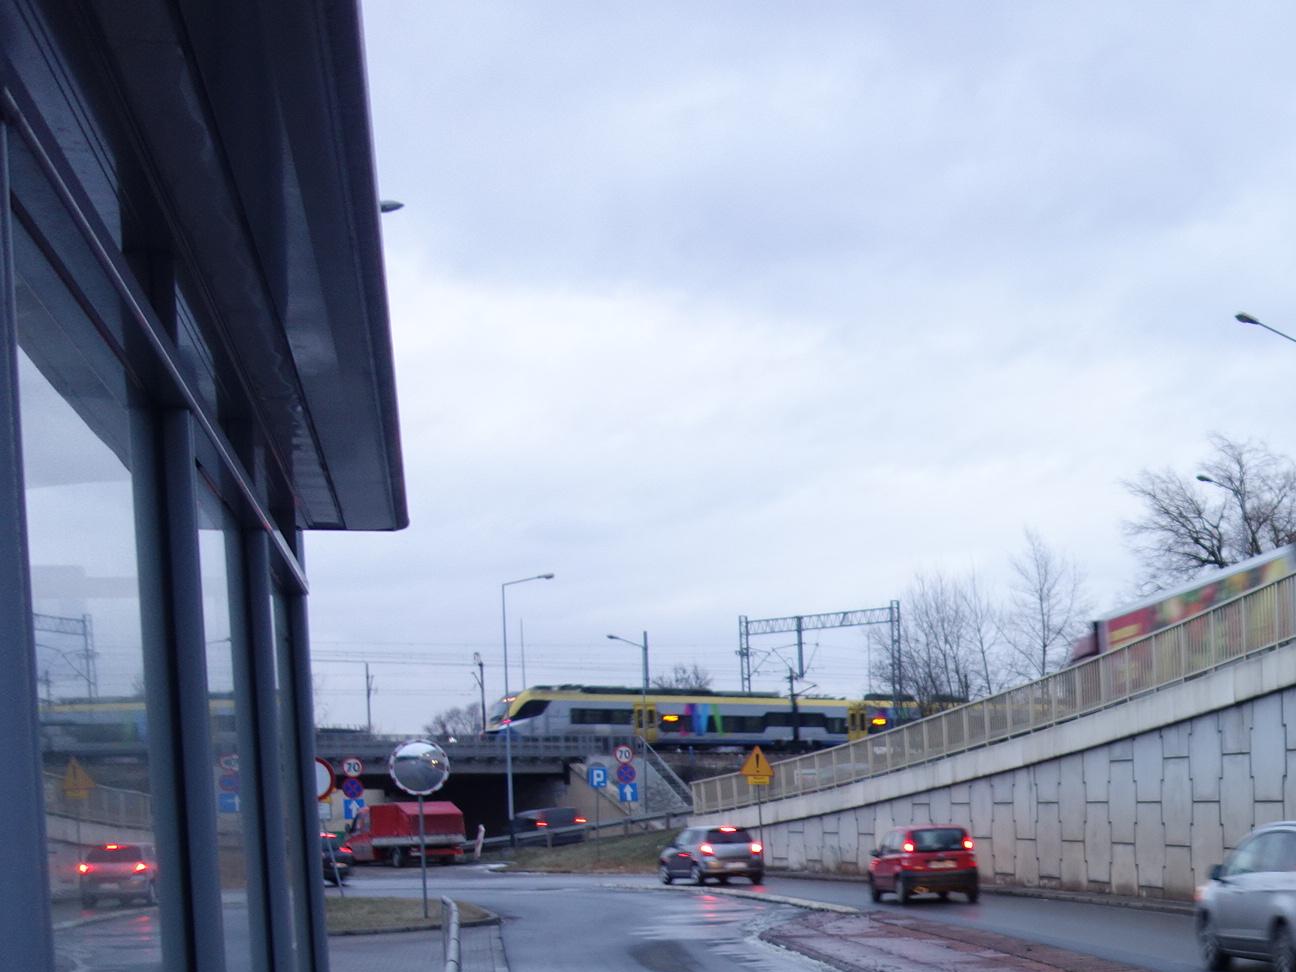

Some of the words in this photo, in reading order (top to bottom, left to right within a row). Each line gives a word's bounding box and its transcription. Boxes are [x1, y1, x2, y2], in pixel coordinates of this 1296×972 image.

[617, 749, 631, 760] 70
[346, 762, 361, 773] 70
[593, 770, 604, 786] P
